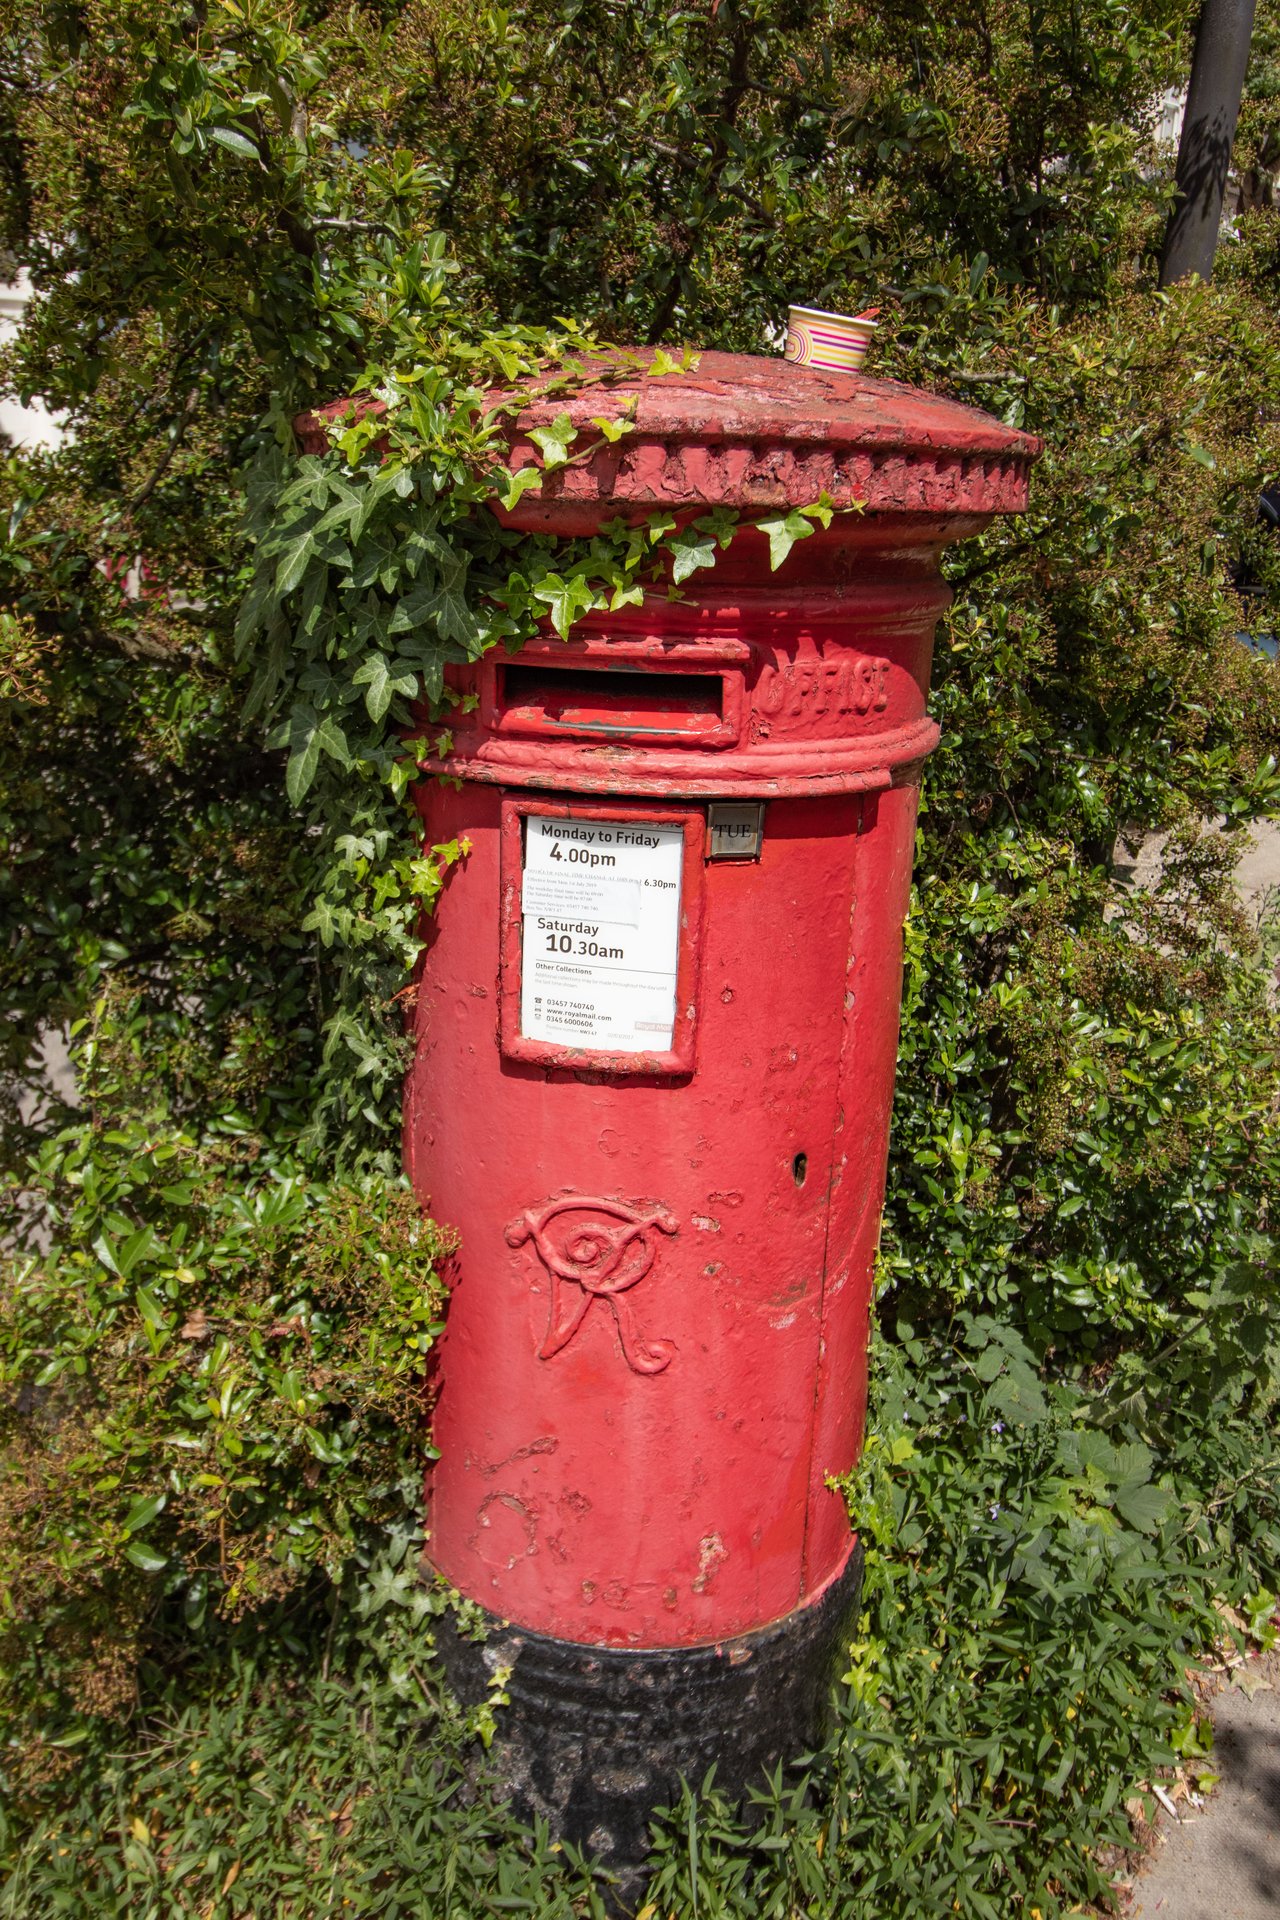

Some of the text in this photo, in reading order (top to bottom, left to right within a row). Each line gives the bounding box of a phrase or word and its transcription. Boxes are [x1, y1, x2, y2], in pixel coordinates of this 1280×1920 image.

[541, 824, 660, 849] Monday to Friday
[715, 824, 751, 838] TUE
[549, 842, 616, 868] 4.00pm
[644, 879, 677, 890] 6.30pm
[537, 917, 599, 937] Saturday
[545, 933, 624, 959] 10.30am
[535, 962, 593, 976] Other Collections
[546, 999, 595, 1011] 03457 740740
[546, 1007, 612, 1022] www.royalmail.com
[546, 1015, 593, 1028] 0345 6000606
